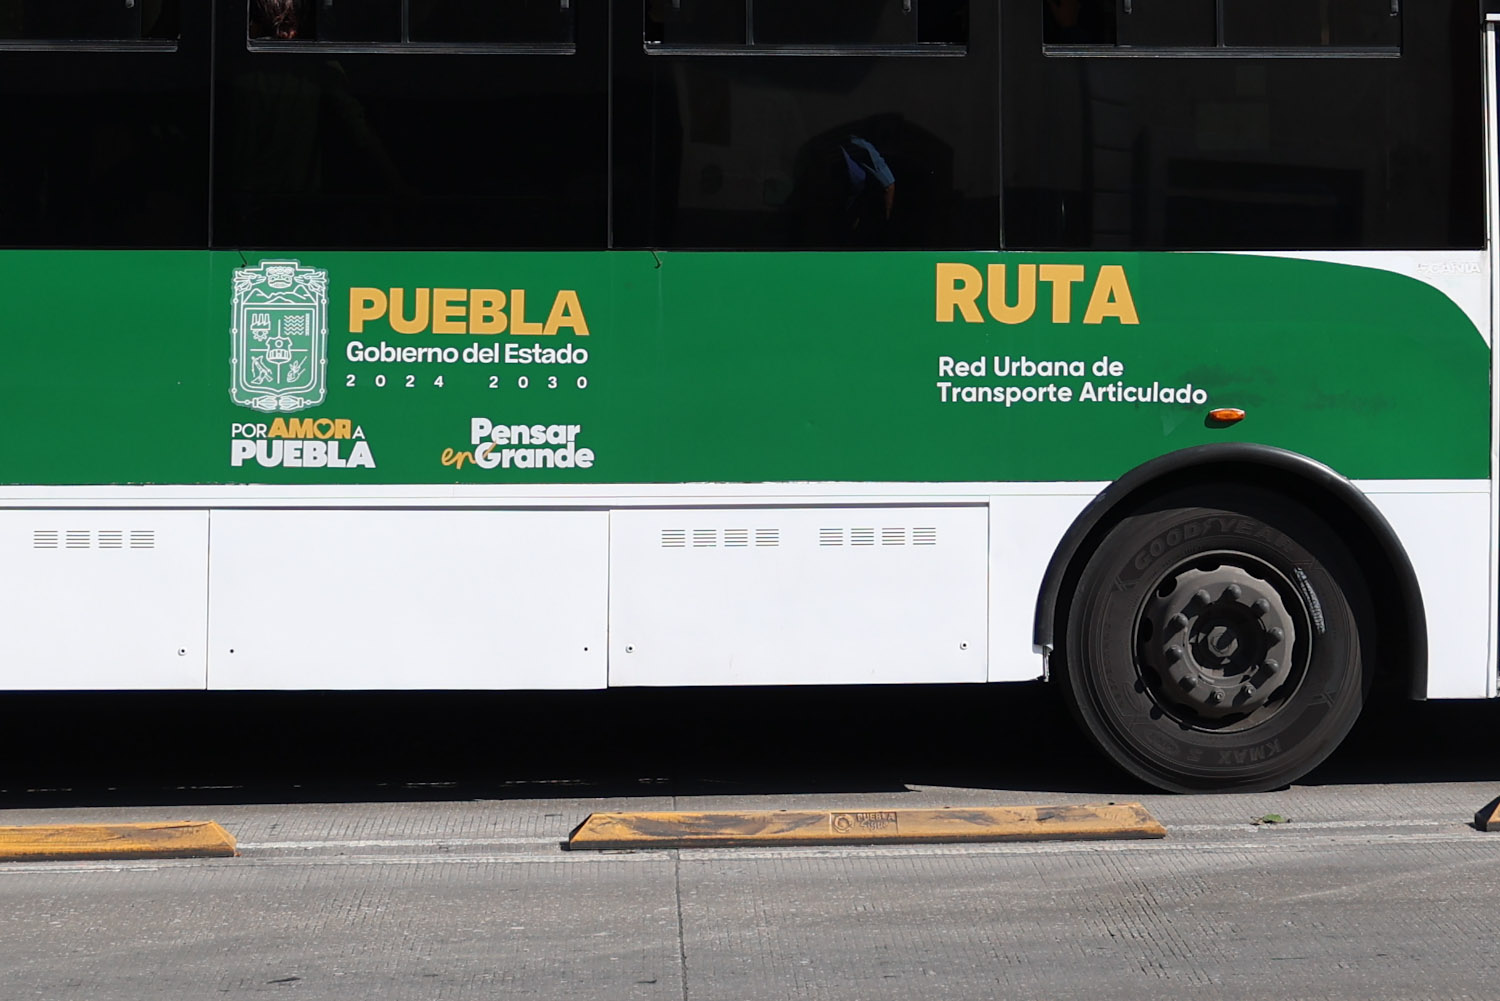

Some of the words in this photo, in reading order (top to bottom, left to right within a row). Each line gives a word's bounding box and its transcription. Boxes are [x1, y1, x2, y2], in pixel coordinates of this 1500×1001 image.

[935, 262, 1140, 325] RUTA
[349, 287, 590, 336] PUEBLA
[462, 342, 500, 364] del
[504, 343, 589, 364] Estado
[938, 355, 985, 377] Red
[993, 355, 1085, 377] Urbana
[1092, 356, 1124, 377] de
[936, 381, 1072, 407] Transporte
[1079, 381, 1208, 405] Articulado
[231, 423, 267, 439] POR
[267, 417, 352, 439] AMOR
[352, 425, 366, 440] A
[470, 417, 581, 446] Pensar
[231, 439, 377, 469] PUEBLA
[441, 446, 477, 470] en
[474, 442, 596, 469] Grande
[1134, 516, 1292, 571] GOODYEAR
[856, 813, 896, 821] PUEBLA
